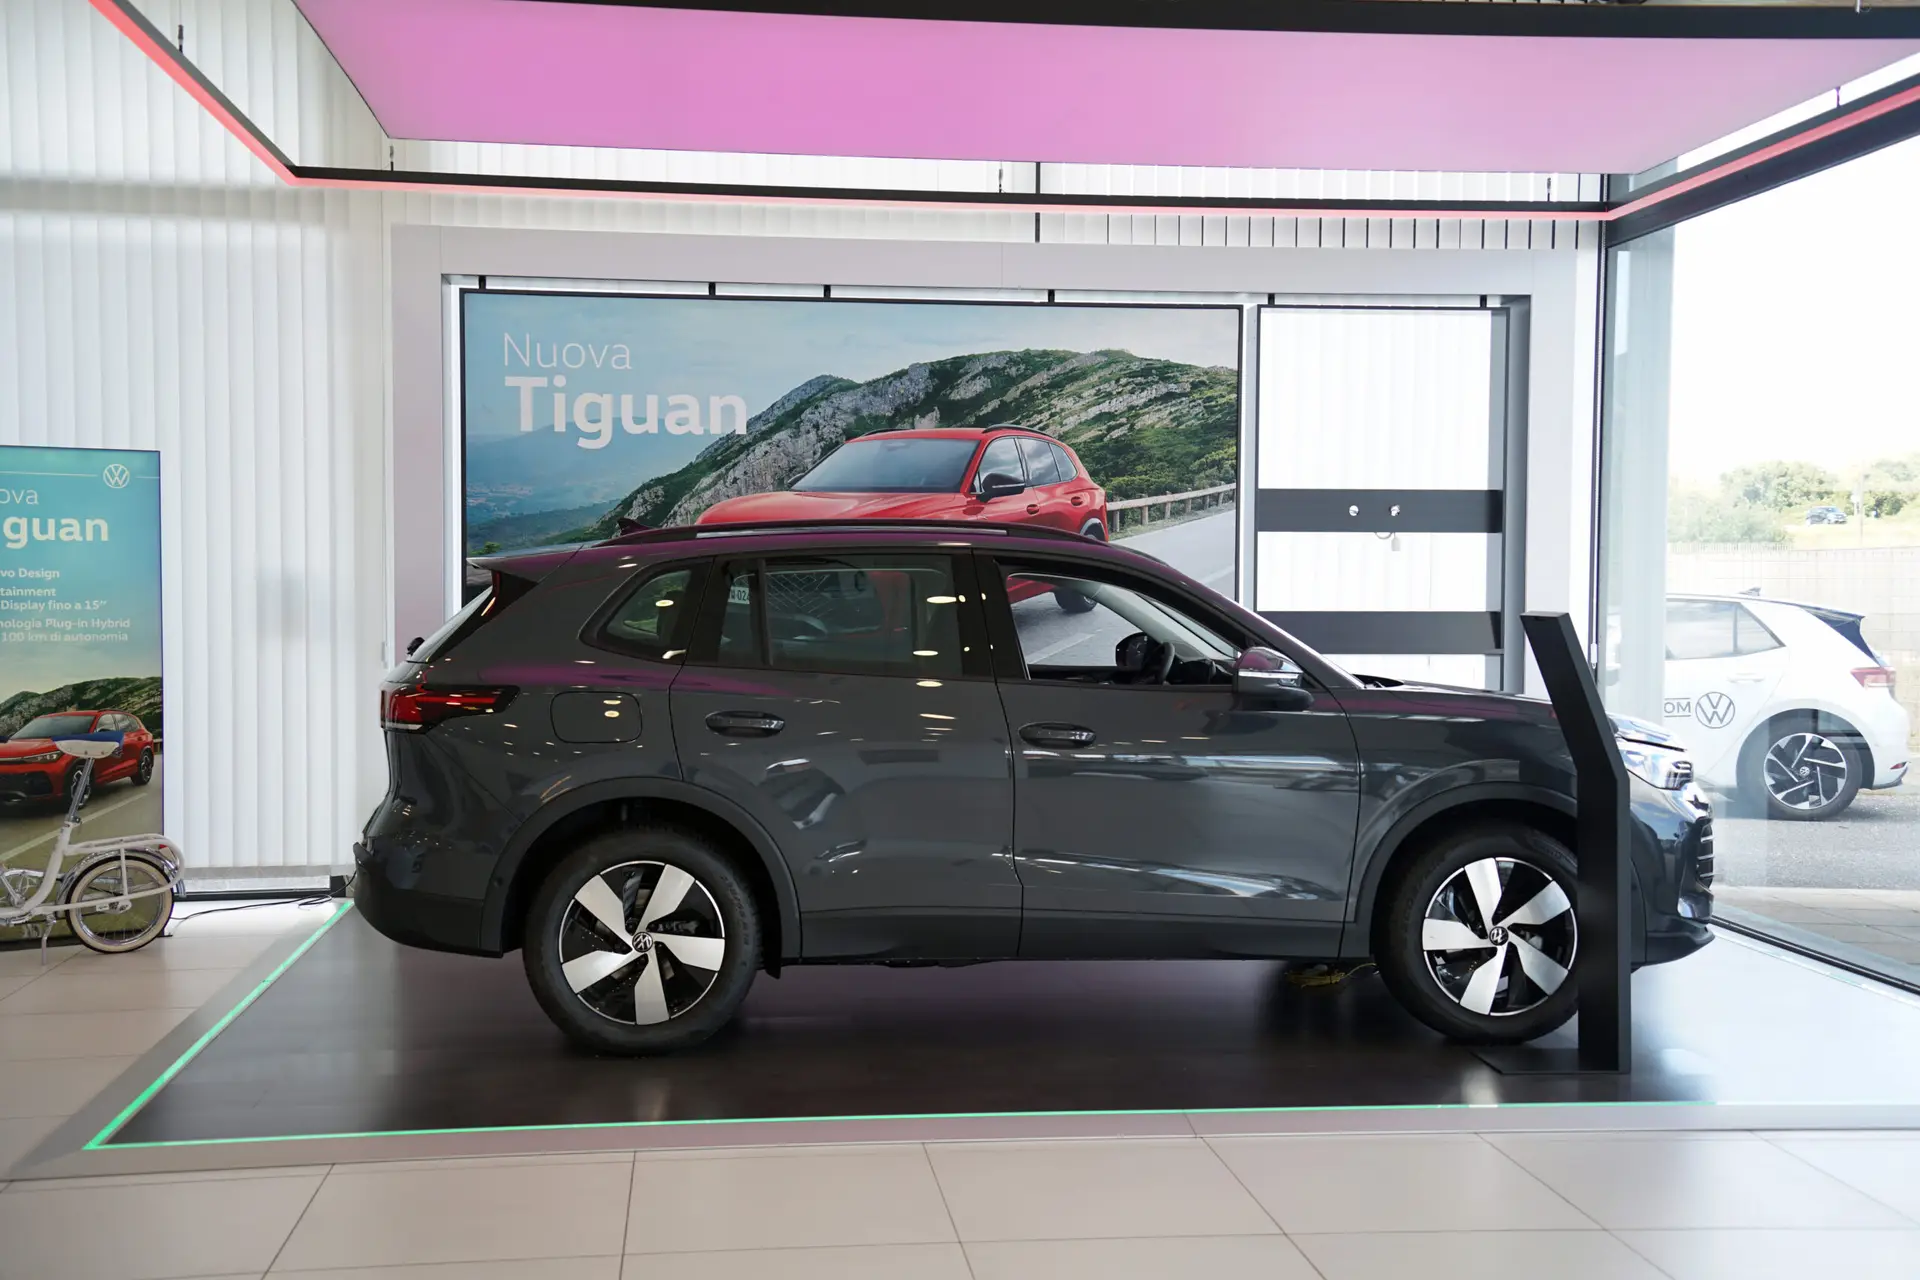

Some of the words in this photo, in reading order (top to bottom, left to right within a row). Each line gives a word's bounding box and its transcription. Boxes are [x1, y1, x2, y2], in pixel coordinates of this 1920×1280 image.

[504, 332, 632, 370] Nuova
[505, 375, 747, 450] Tiguan
[3, 516, 109, 549] guan
[18, 568, 60, 580] Design
[1, 599, 45, 612] Display
[48, 599, 71, 610] fino
[74, 602, 82, 610] a
[45, 617, 88, 630] Plug-in
[91, 617, 131, 630] Hybrid
[2, 631, 25, 642] 100
[28, 631, 47, 642] km
[50, 631, 62, 642] di
[63, 631, 128, 642] autonomia
[1695, 691, 1736, 729] VW
